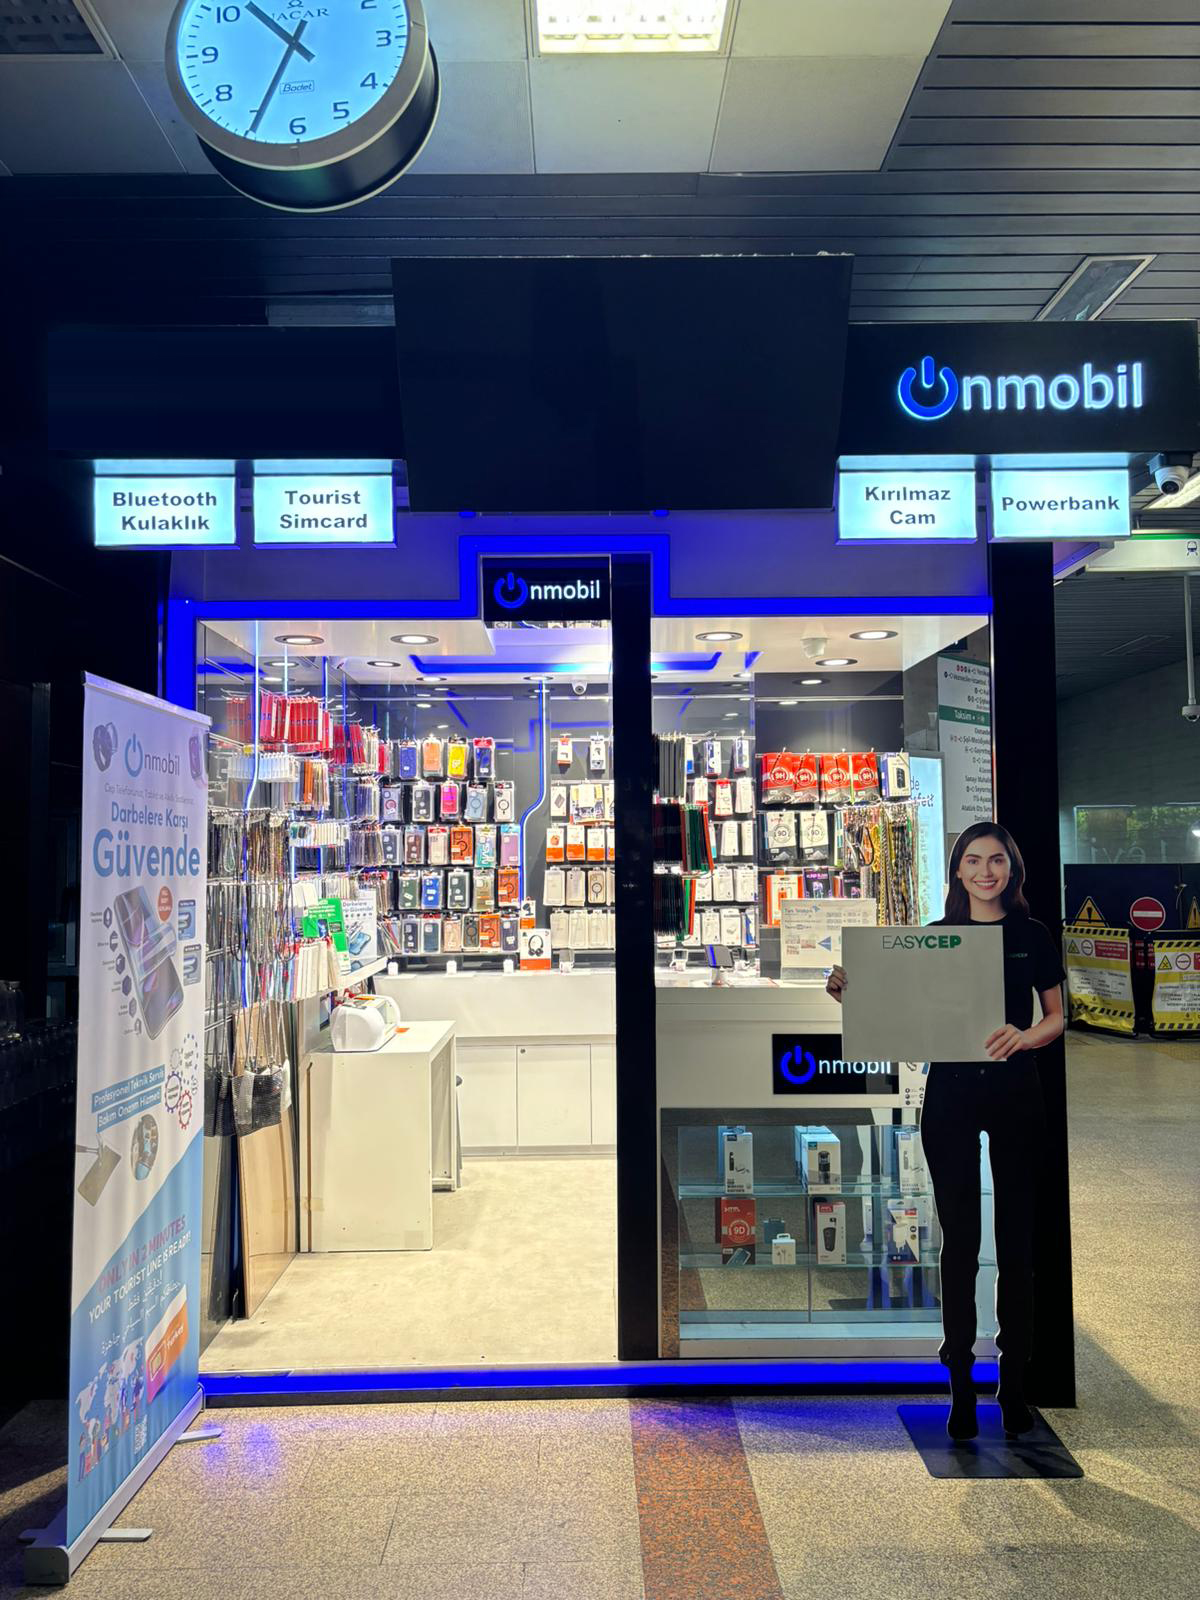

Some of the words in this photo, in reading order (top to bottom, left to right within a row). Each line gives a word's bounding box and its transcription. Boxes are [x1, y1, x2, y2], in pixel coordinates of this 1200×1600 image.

[216, 5, 241, 24] 10
[376, 29, 392, 48] 3
[201, 46, 219, 64] 9
[282, 82, 313, 92] Bodet
[360, 72, 379, 90] 4
[215, 84, 233, 102] 8
[332, 101, 350, 120] 5
[289, 117, 307, 135] 6
[112, 491, 218, 507] Bluetooth
[284, 490, 361, 505] Tourist
[865, 485, 952, 501] Kırılmaz
[1001, 495, 1121, 512] Powerbank
[121, 515, 210, 531] Kulaklık
[279, 513, 368, 529] Simcard
[889, 510, 936, 526] Cam
[111, 800, 163, 826] Darbelere
[165, 808, 189, 832] Karşı
[93, 828, 200, 877] Güvende
[882, 935, 962, 950] EASYCEP
[149, 1214, 186, 1254] MINUTES
[89, 1295, 111, 1324] YOUR
[113, 1267, 145, 1304] TOURIST
[147, 1254, 162, 1276] LINE
